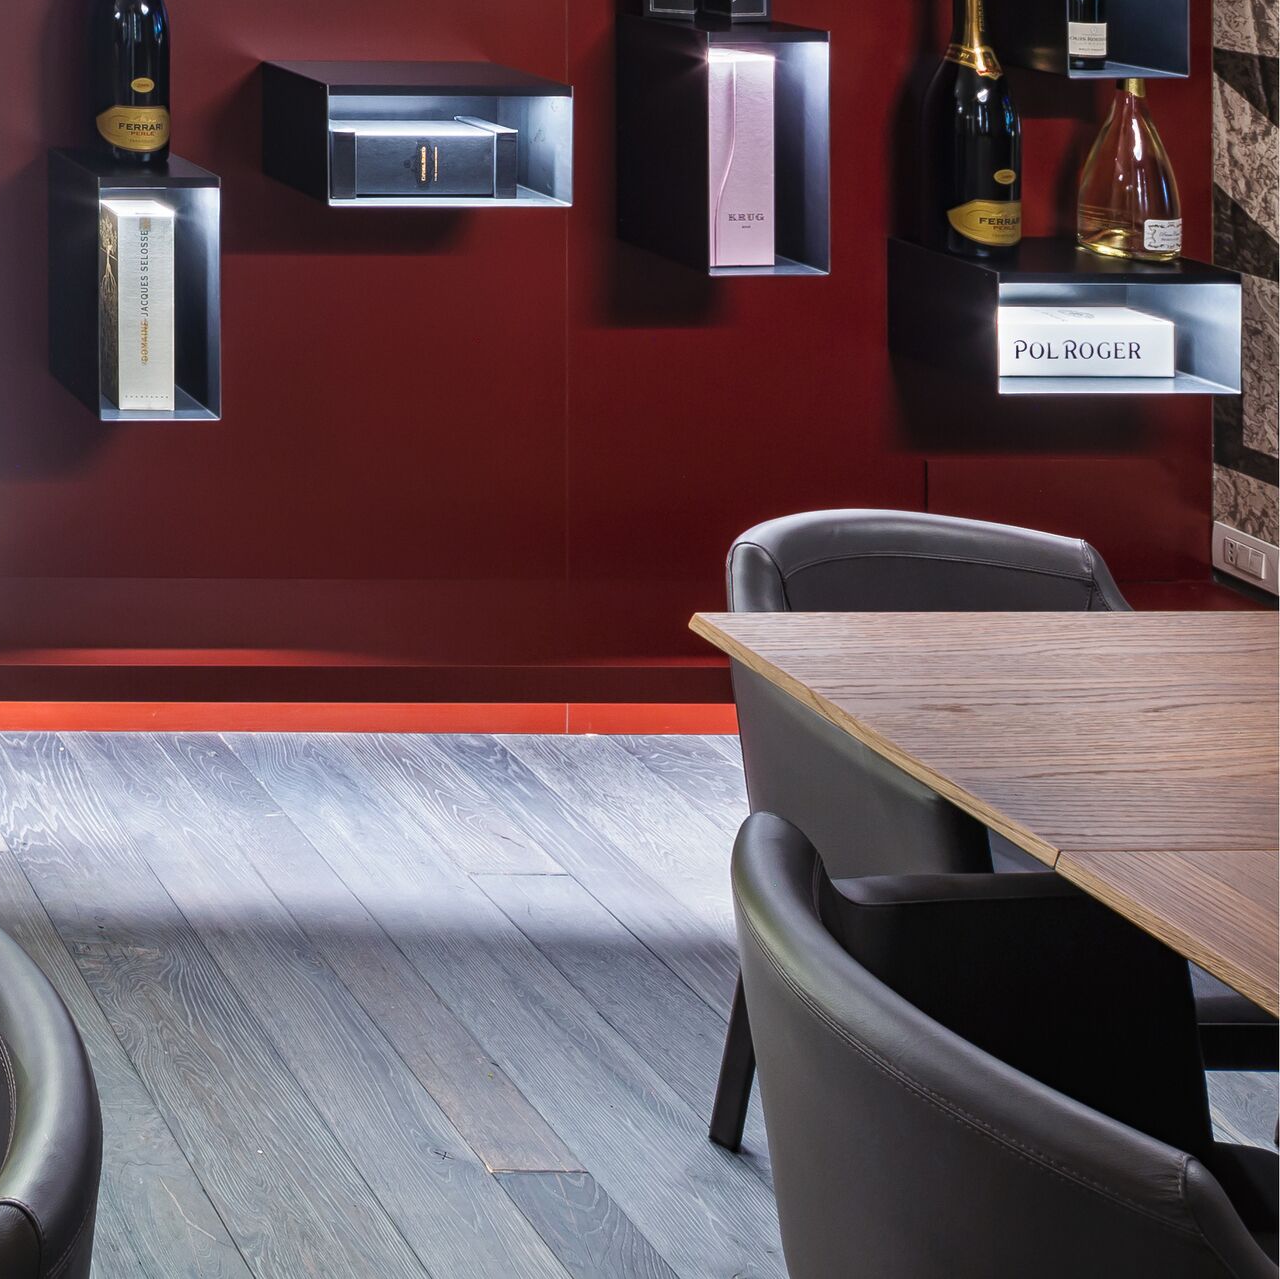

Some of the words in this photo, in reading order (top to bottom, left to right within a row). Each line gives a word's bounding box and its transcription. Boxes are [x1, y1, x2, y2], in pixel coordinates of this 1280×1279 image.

[728, 213, 765, 222] KRUG
[140, 230, 149, 272] SELOSSE
[140, 275, 149, 318] JACQUES
[1014, 340, 1059, 360] POL
[1063, 340, 1142, 360] ROGER
